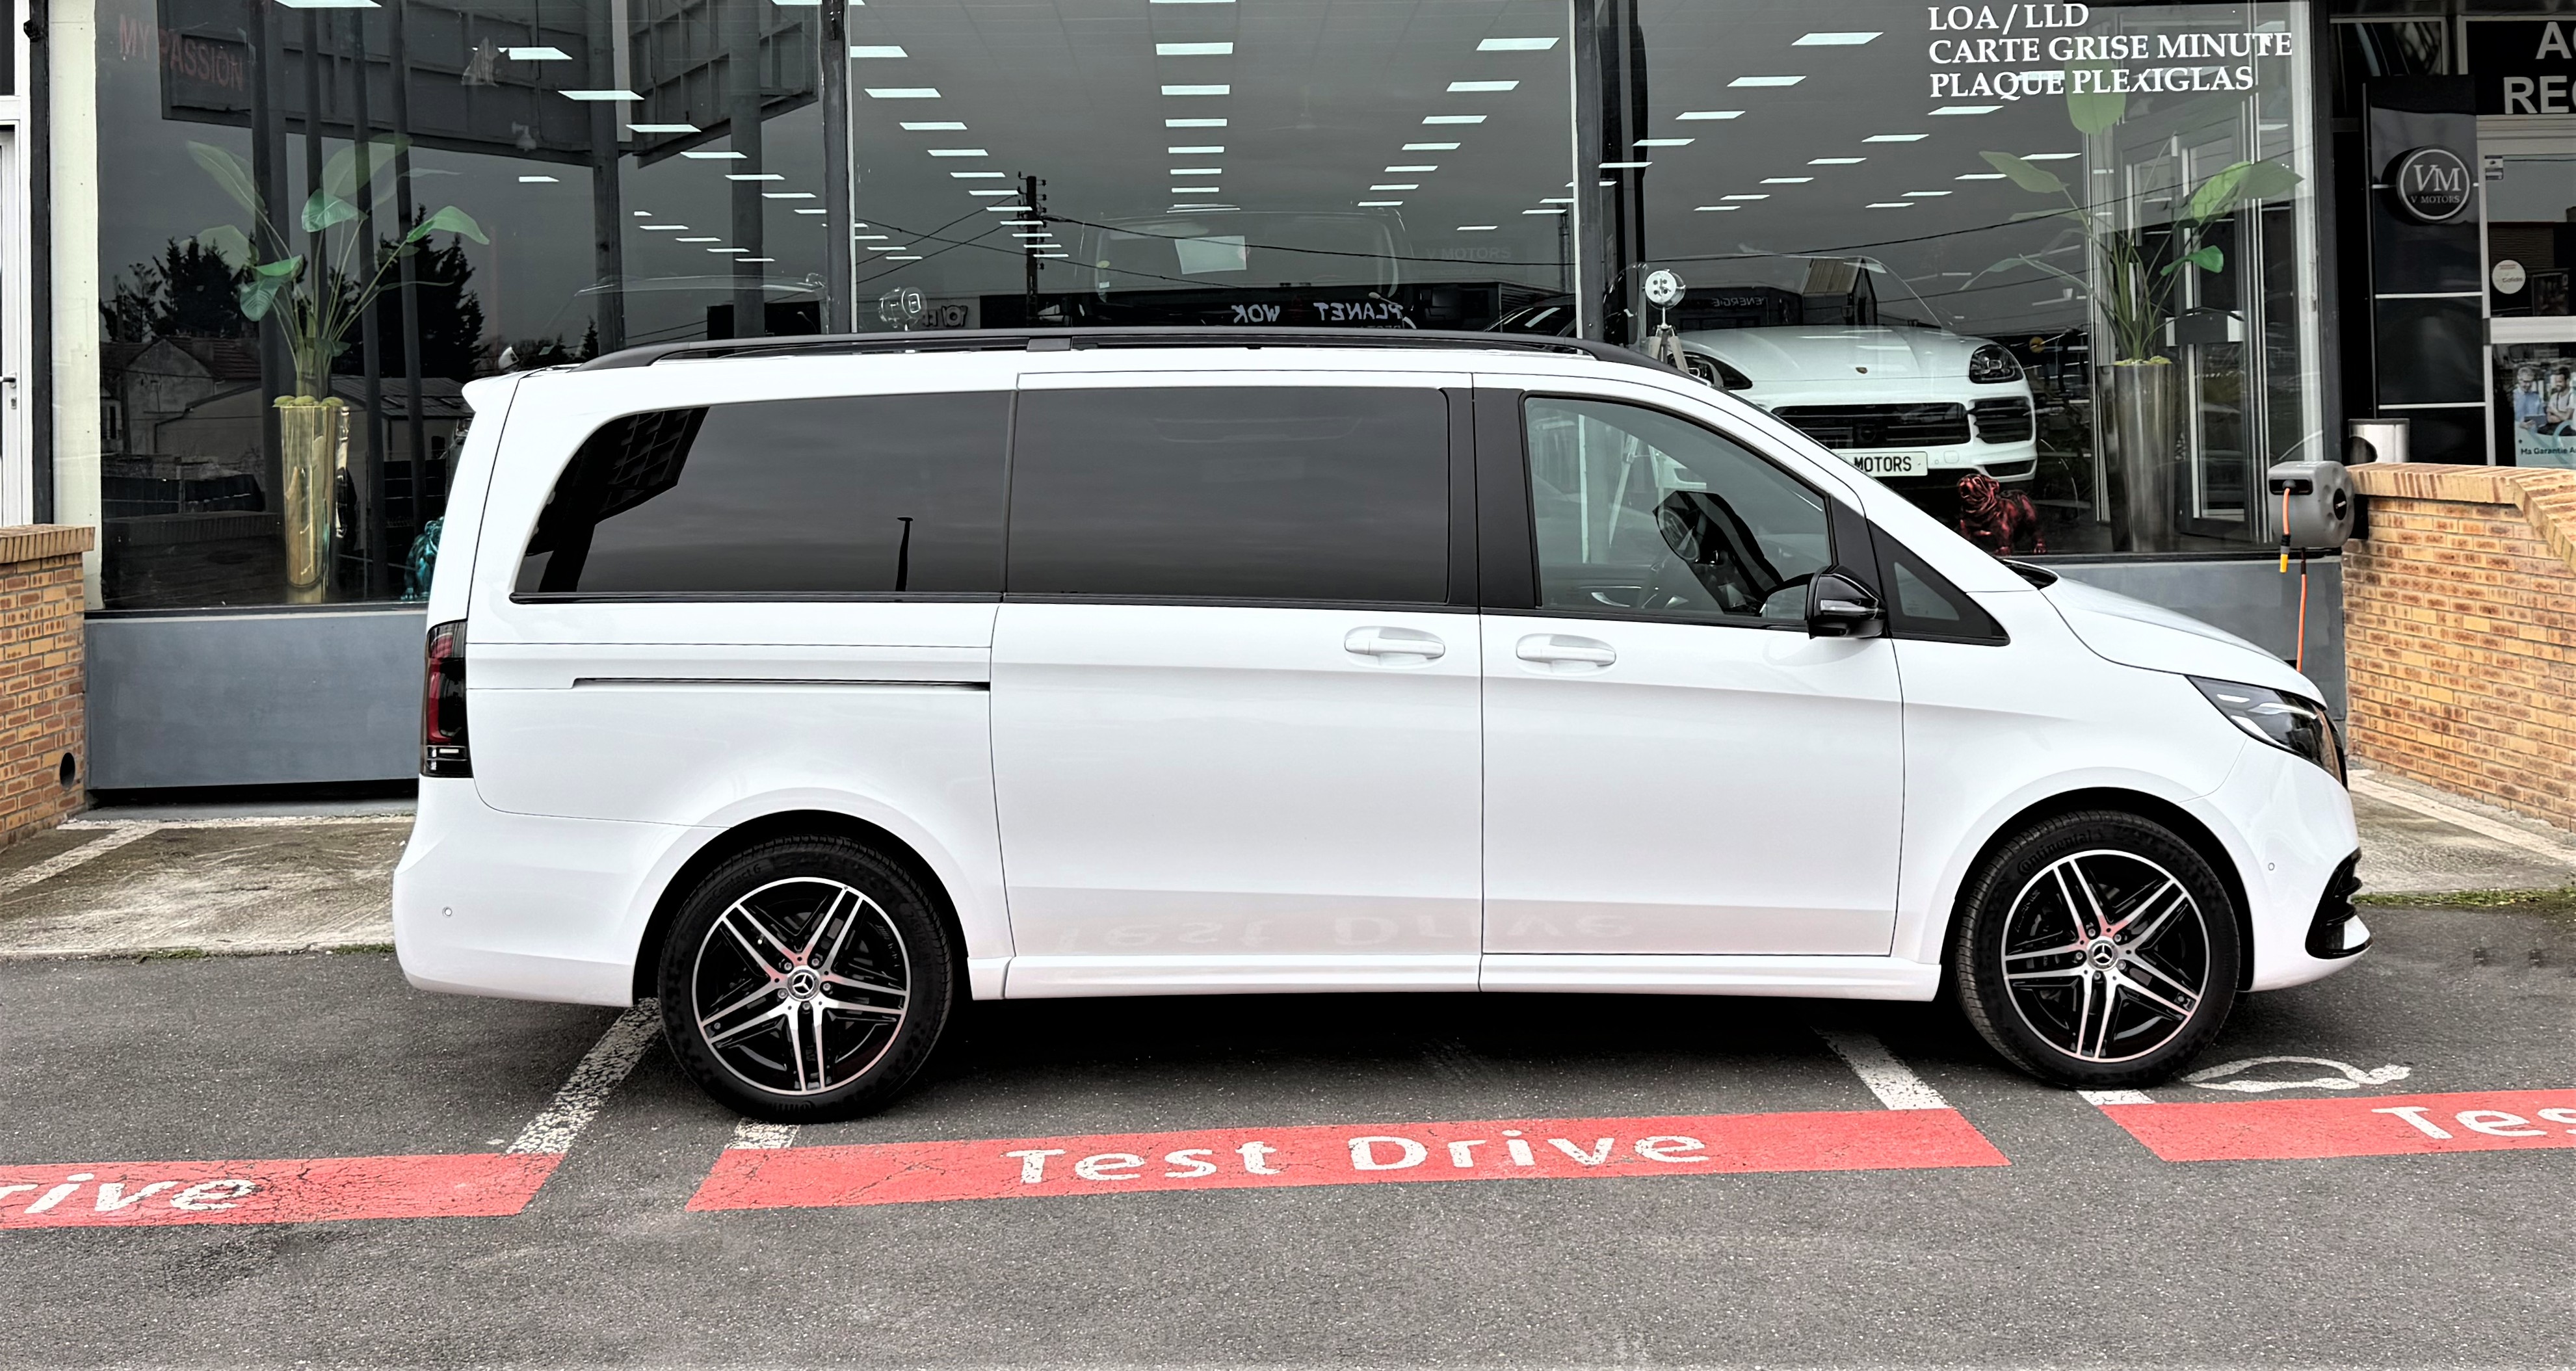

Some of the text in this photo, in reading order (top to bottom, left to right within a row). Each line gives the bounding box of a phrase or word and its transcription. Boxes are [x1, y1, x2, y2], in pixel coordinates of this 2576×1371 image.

[1928, 5, 1999, 31] LOA
[2024, 3, 2089, 28] LLD
[119, 13, 244, 92] MY PASSION
[1929, 33, 2293, 64] CARTE GRISE MINUTE
[2535, 21, 2576, 59] A
[1930, 66, 2254, 101] PLAQUE PLEXIGLAS
[2503, 75, 2576, 115] RE
[2413, 164, 2462, 191] VM
[1854, 456, 1912, 473] MOTORS
[2017, 829, 2092, 876] Continental
[1005, 1130, 1710, 1183] Test Drive
